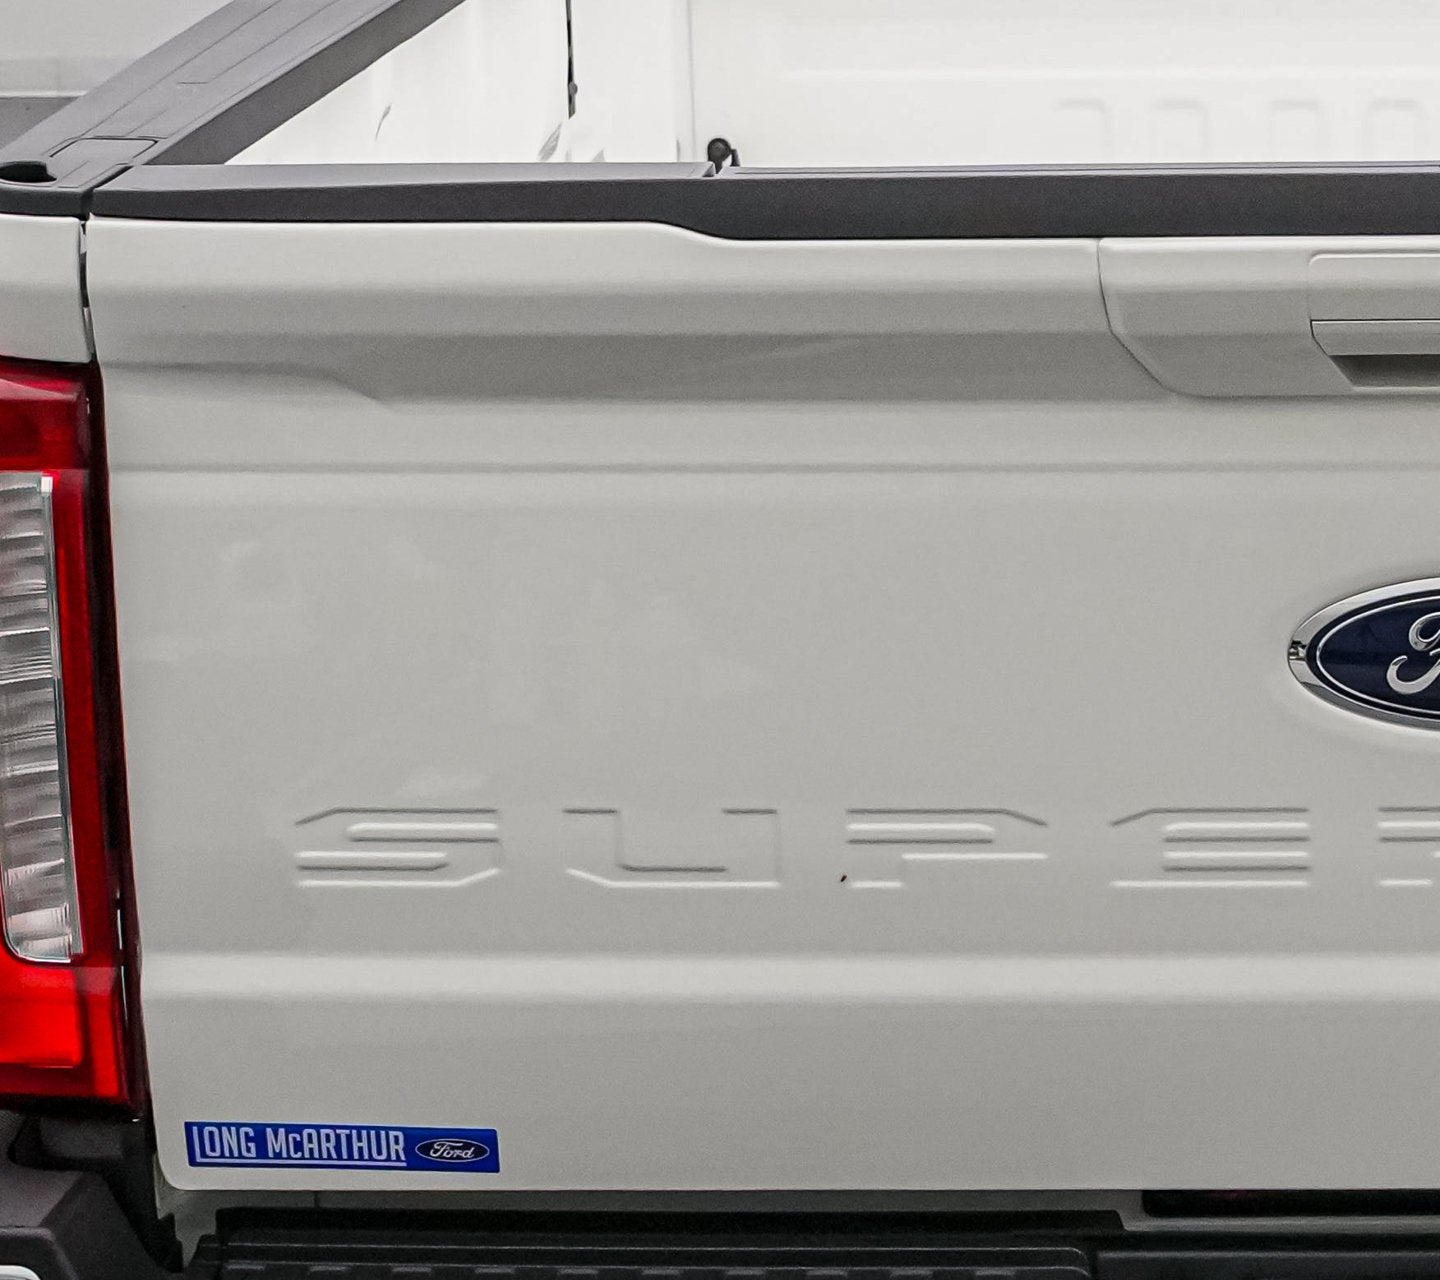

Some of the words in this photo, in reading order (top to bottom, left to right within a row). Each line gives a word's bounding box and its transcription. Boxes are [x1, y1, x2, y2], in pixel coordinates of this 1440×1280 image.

[191, 1125, 257, 1161] LONG
[265, 1126, 407, 1161] McARTHUR
[429, 1140, 475, 1159] Ford
